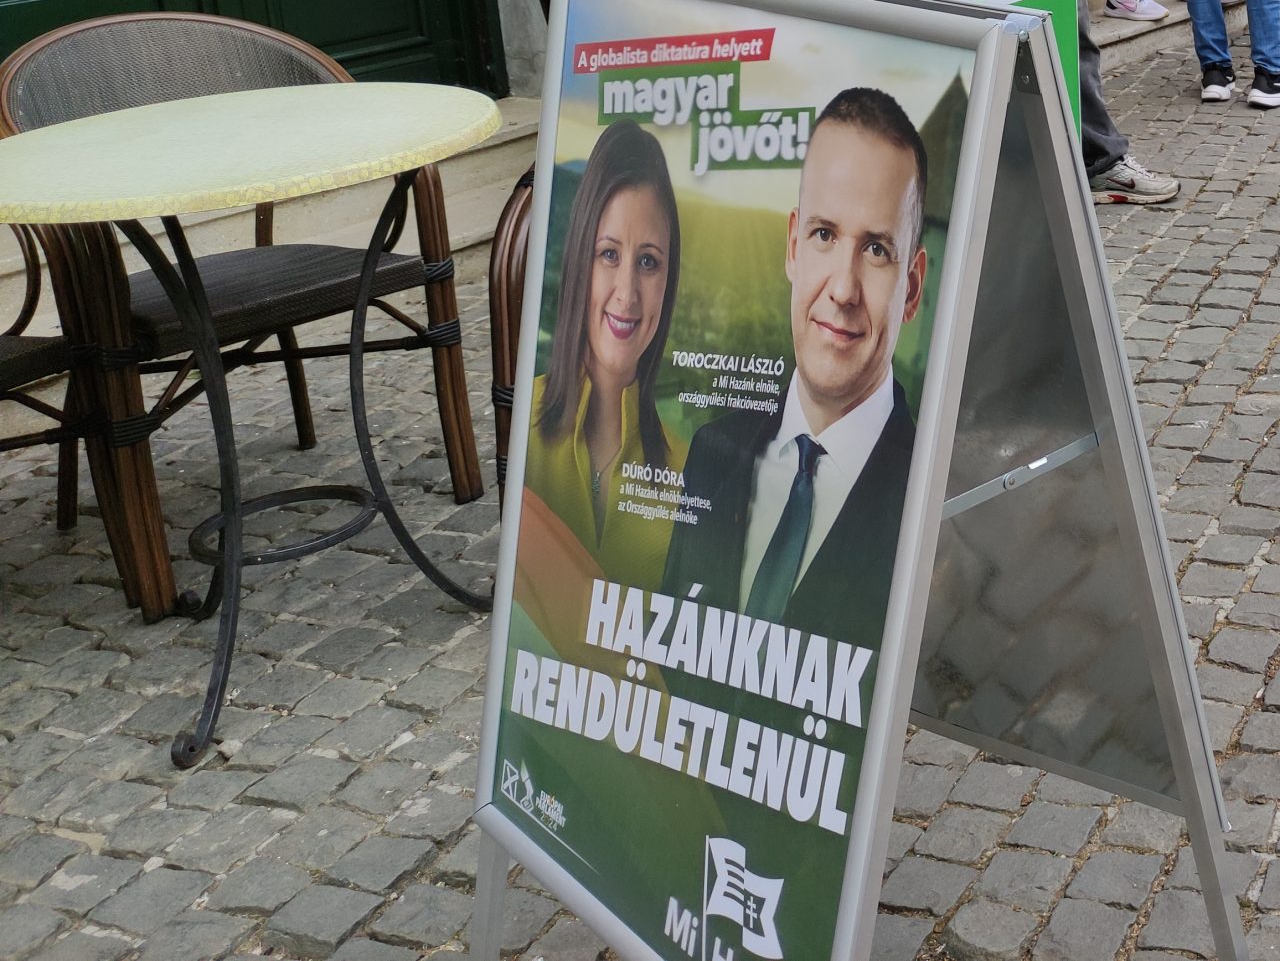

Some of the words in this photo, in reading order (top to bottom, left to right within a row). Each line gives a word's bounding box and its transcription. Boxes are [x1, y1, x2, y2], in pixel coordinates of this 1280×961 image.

[577, 51, 588, 68] A
[590, 48, 648, 71] globalista
[651, 42, 709, 62] diktatúra
[712, 38, 763, 61] helyett
[603, 73, 734, 126] magyar
[694, 111, 809, 176] jövőt!
[672, 350, 739, 372] TOROCZKAI
[741, 354, 785, 376] LÁSZLÓ
[712, 378, 718, 388] a
[719, 375, 729, 389] Mi
[729, 376, 754, 392] Hazánk
[620, 485, 625, 494] a
[625, 482, 634, 496] Mi
[635, 485, 658, 500] Hazánk
[622, 461, 652, 482] DÚRÓ
[654, 467, 685, 488] DÓRA
[618, 501, 625, 511] az
[585, 578, 874, 728] HAZÁNKNAK
[511, 649, 848, 836] RENDÜLETLENÜL
[664, 896, 699, 958] Mi
